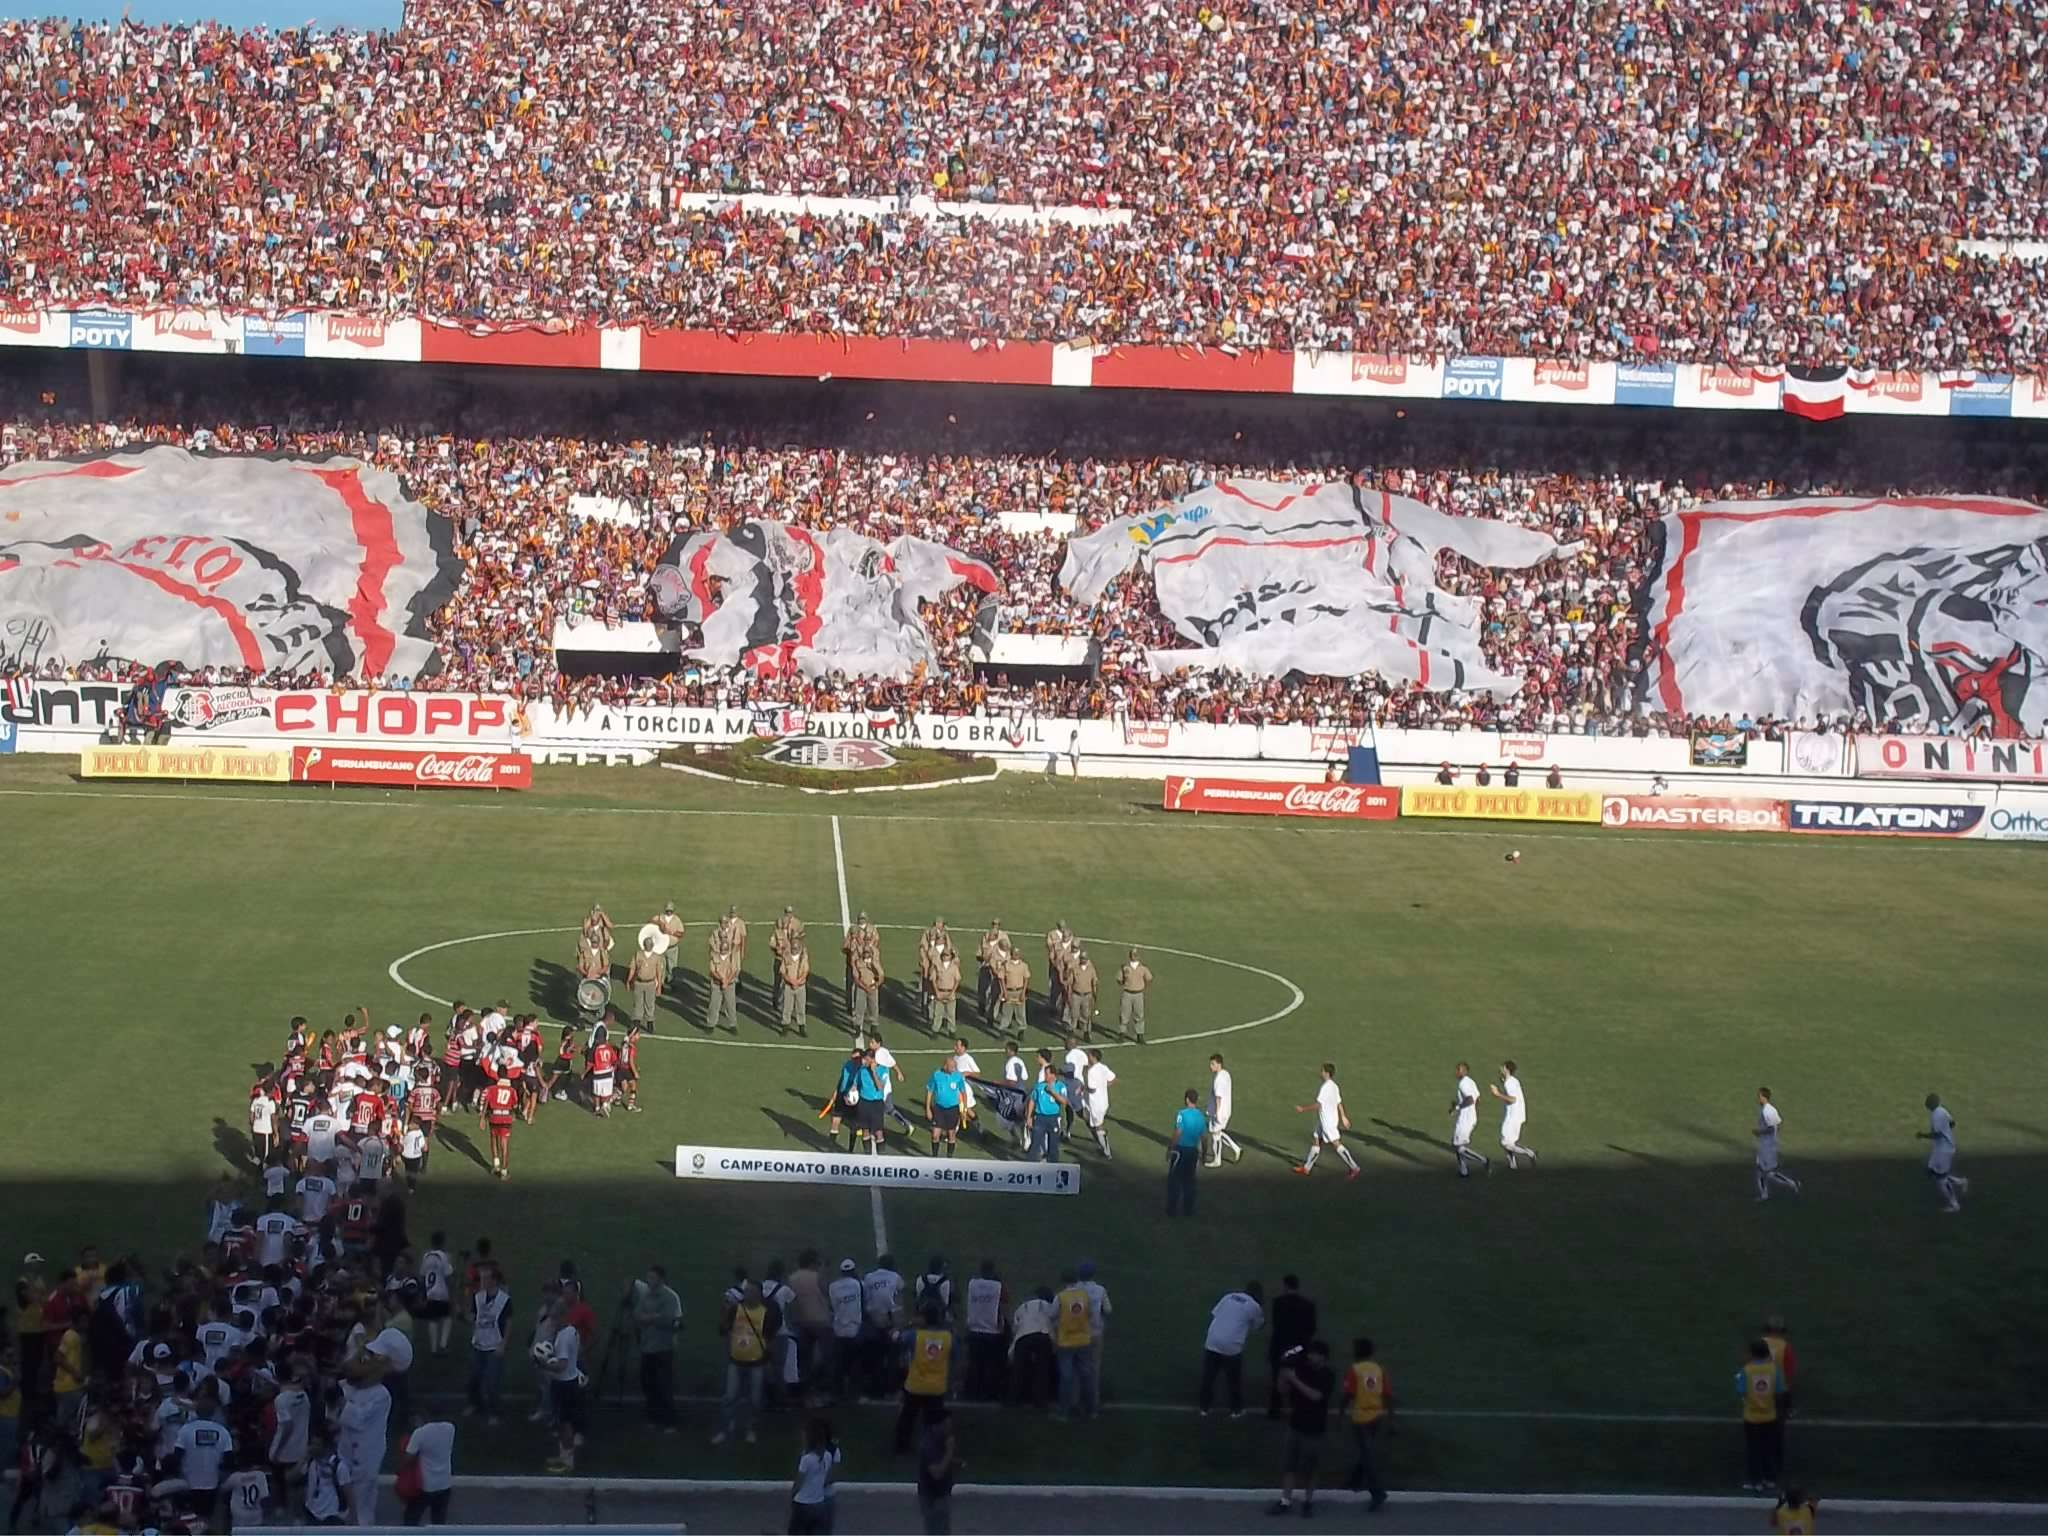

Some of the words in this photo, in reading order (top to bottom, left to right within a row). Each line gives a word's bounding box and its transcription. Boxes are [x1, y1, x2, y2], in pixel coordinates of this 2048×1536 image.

[71, 327, 130, 347] POTY
[1444, 377, 1501, 396] POTY
[275, 695, 506, 736] CHOPP
[601, 714, 611, 731] A
[624, 715, 714, 734] TORCIDA
[933, 724, 959, 741] DO
[969, 725, 1045, 743] BRAIL
[331, 759, 414, 771] PERNAMBUCANO
[416, 754, 498, 782] Coca-Cola
[500, 765, 521, 775] 2011
[1203, 788, 1284, 801] PERNAMBUCANO
[1285, 784, 1366, 813] Coca-Cola
[1366, 796, 1387, 807] 2011
[1631, 806, 1781, 826] MASTERBOL
[1795, 804, 1949, 828] TRIATON
[419, 1095, 431, 1108] 10
[496, 1088, 511, 1104] 10
[293, 1104, 305, 1122] 10
[720, 1159, 825, 1175] CAMPEONATO
[831, 1164, 920, 1180] BRASILEIRO
[933, 1168, 979, 1182] SÉRIE
[983, 1172, 994, 1182] D
[1007, 1173, 1043, 1185] 2011
[347, 1203, 362, 1221] 10
[427, 1272, 436, 1290] 9
[242, 1483, 258, 1505] 10
